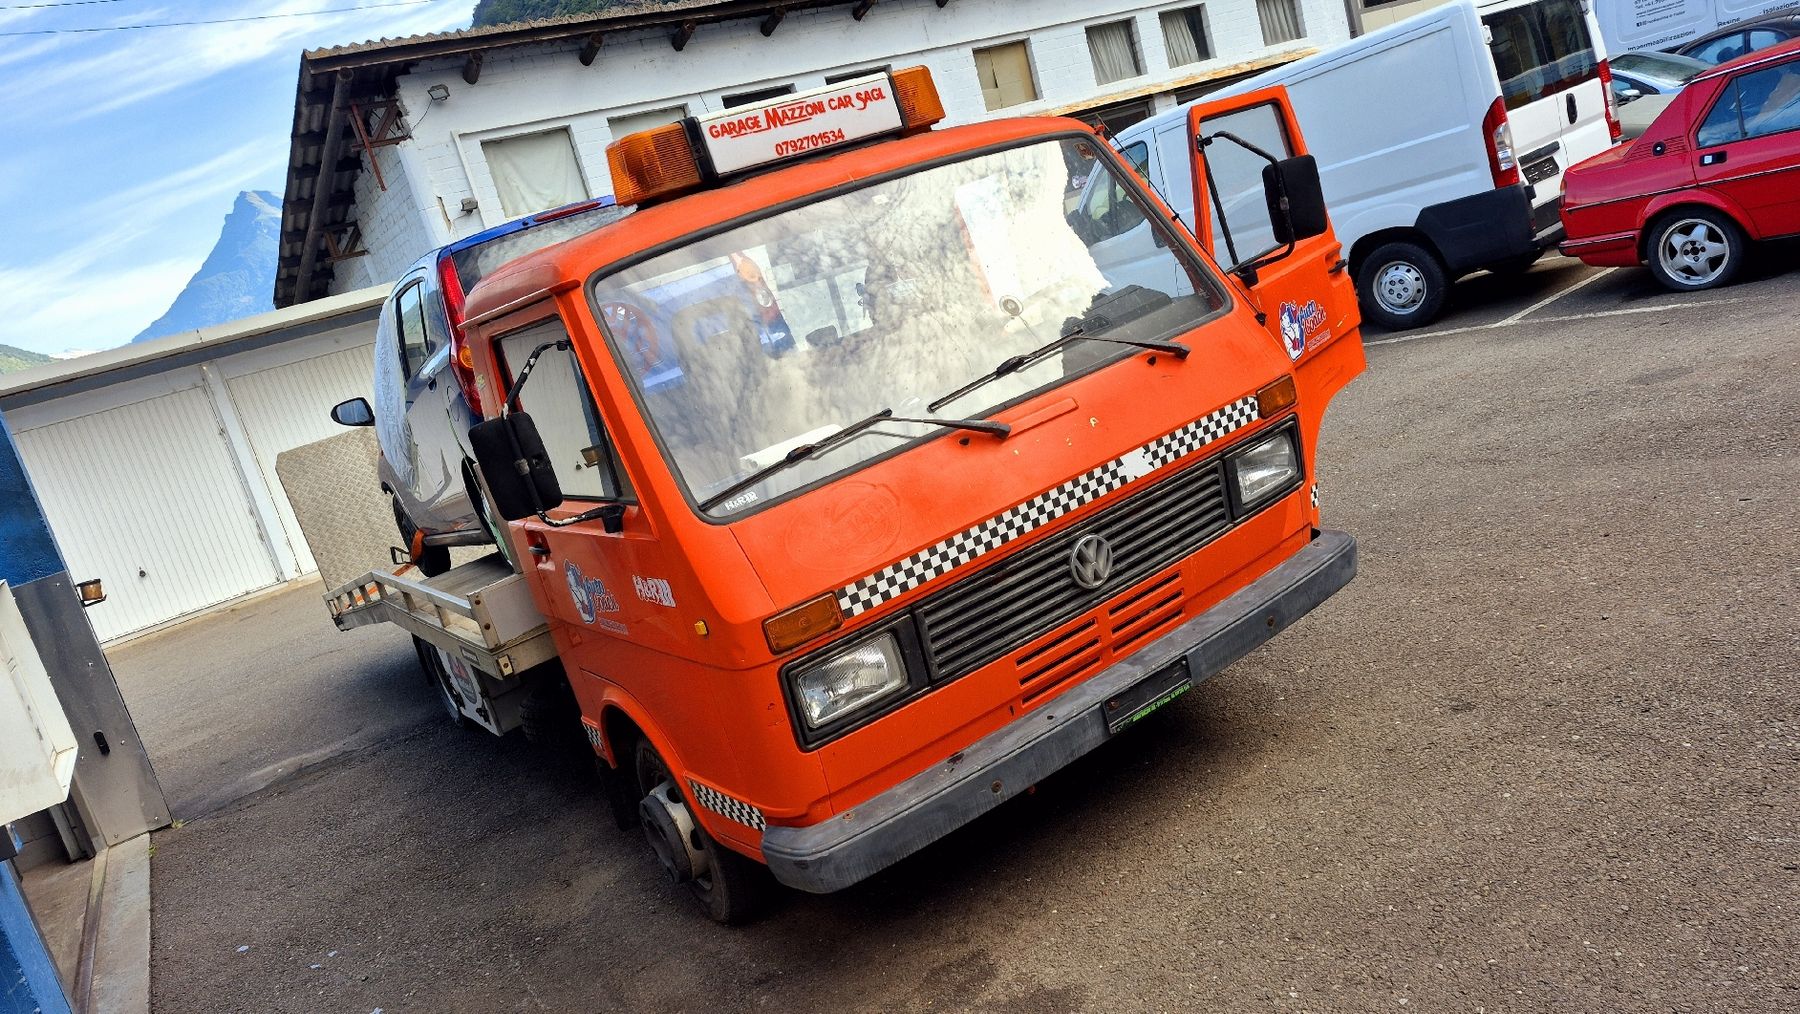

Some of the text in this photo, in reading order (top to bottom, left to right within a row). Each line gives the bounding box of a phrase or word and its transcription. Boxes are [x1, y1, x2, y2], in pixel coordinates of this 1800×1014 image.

[708, 87, 887, 139] GARAGE MAZZONI CAR SAGL
[775, 128, 846, 156] 0792701534
